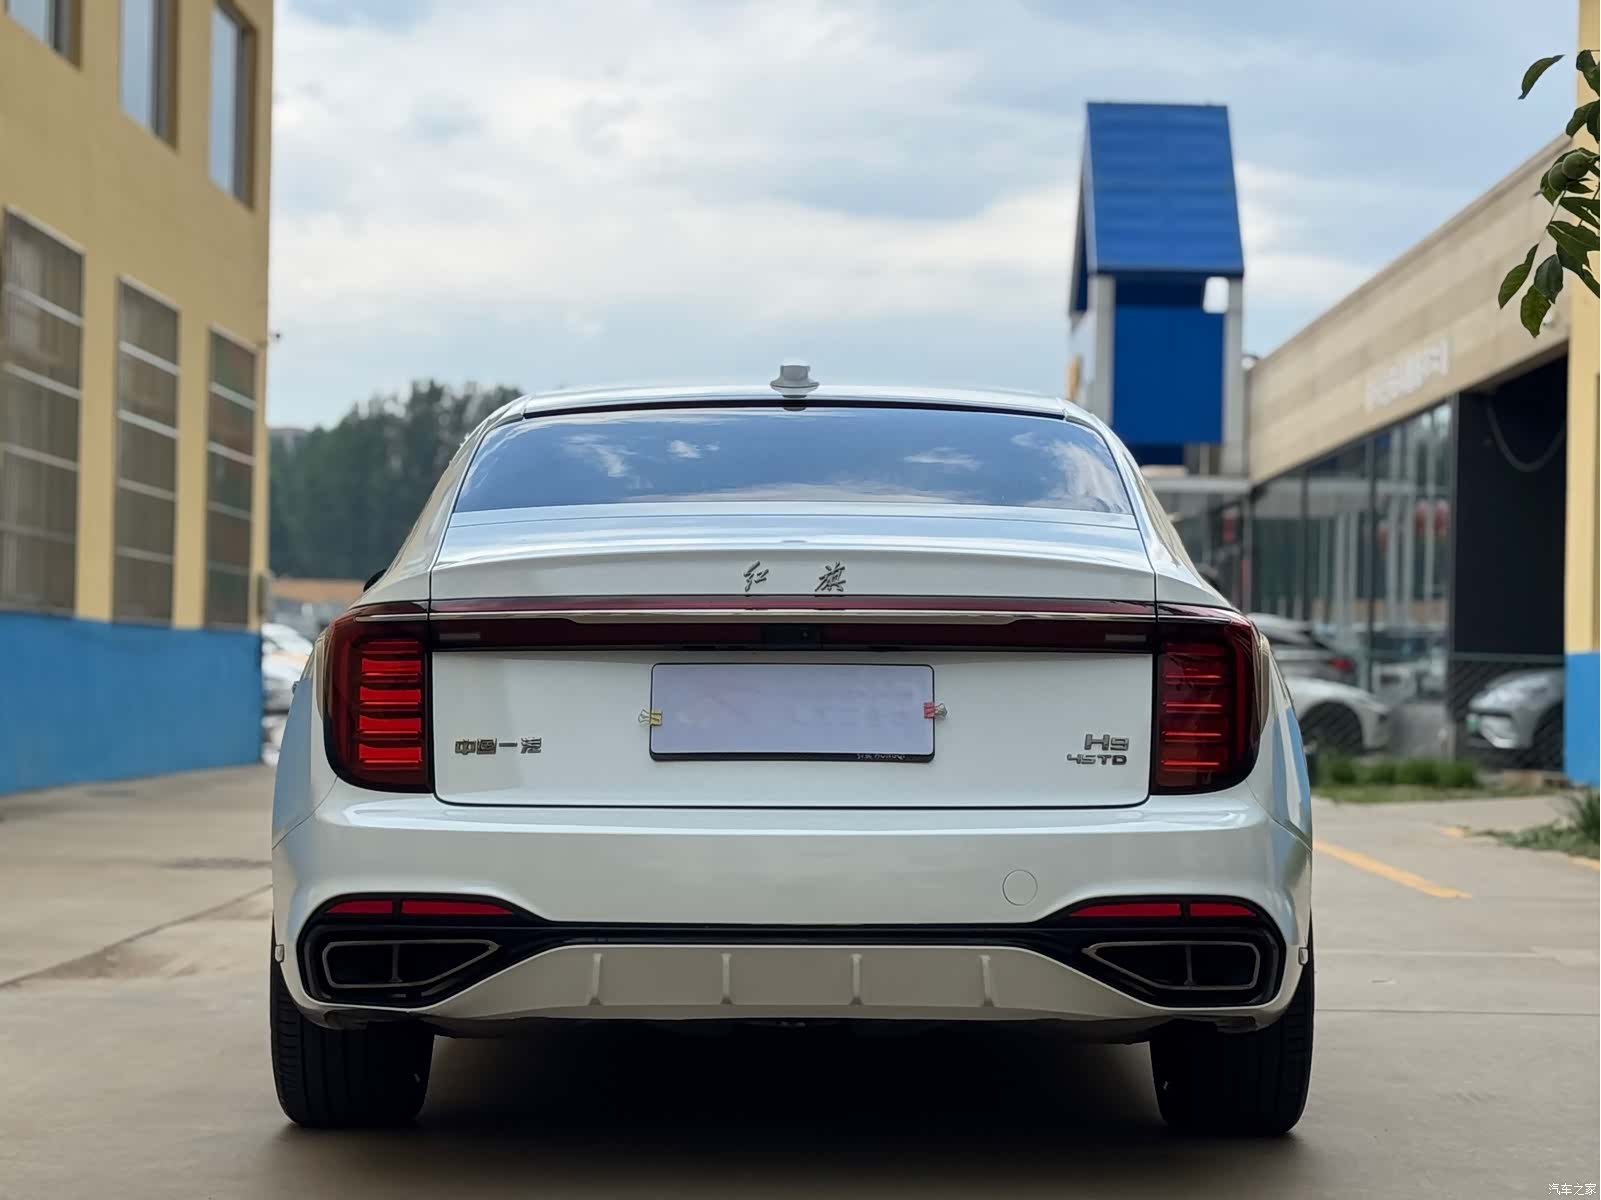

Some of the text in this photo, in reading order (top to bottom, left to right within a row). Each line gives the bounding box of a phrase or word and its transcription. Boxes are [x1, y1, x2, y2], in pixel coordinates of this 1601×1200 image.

[743, 560, 846, 592] 红旗
[454, 738, 542, 755] 中国一汽
[1084, 733, 1129, 751] H9
[1066, 753, 1127, 765] 45TD
